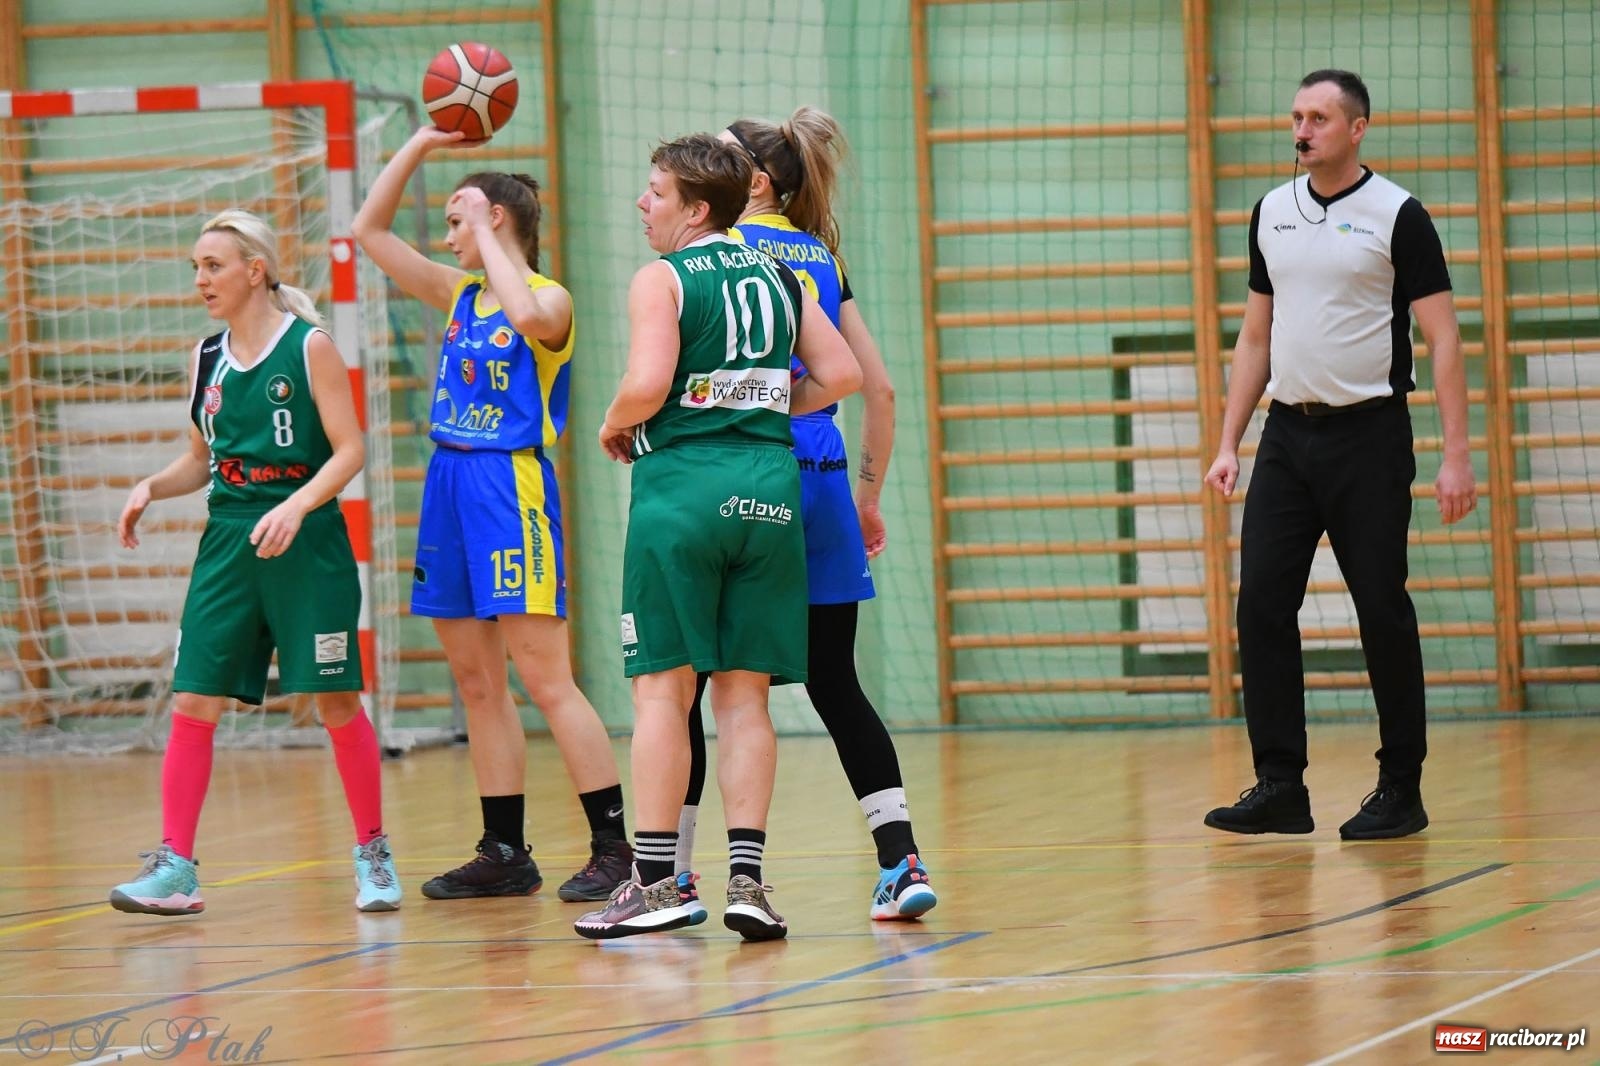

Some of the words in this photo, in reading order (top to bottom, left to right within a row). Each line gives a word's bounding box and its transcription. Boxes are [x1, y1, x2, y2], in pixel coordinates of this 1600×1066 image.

[683, 256, 716, 274] RKK
[722, 276, 774, 362] 10
[486, 360, 510, 391] 15
[713, 386, 788, 404] WAGTECH
[273, 408, 294, 447] 8
[739, 498, 793, 521] Clavis
[528, 508, 545, 584] BASKET
[490, 548, 523, 590] 15
